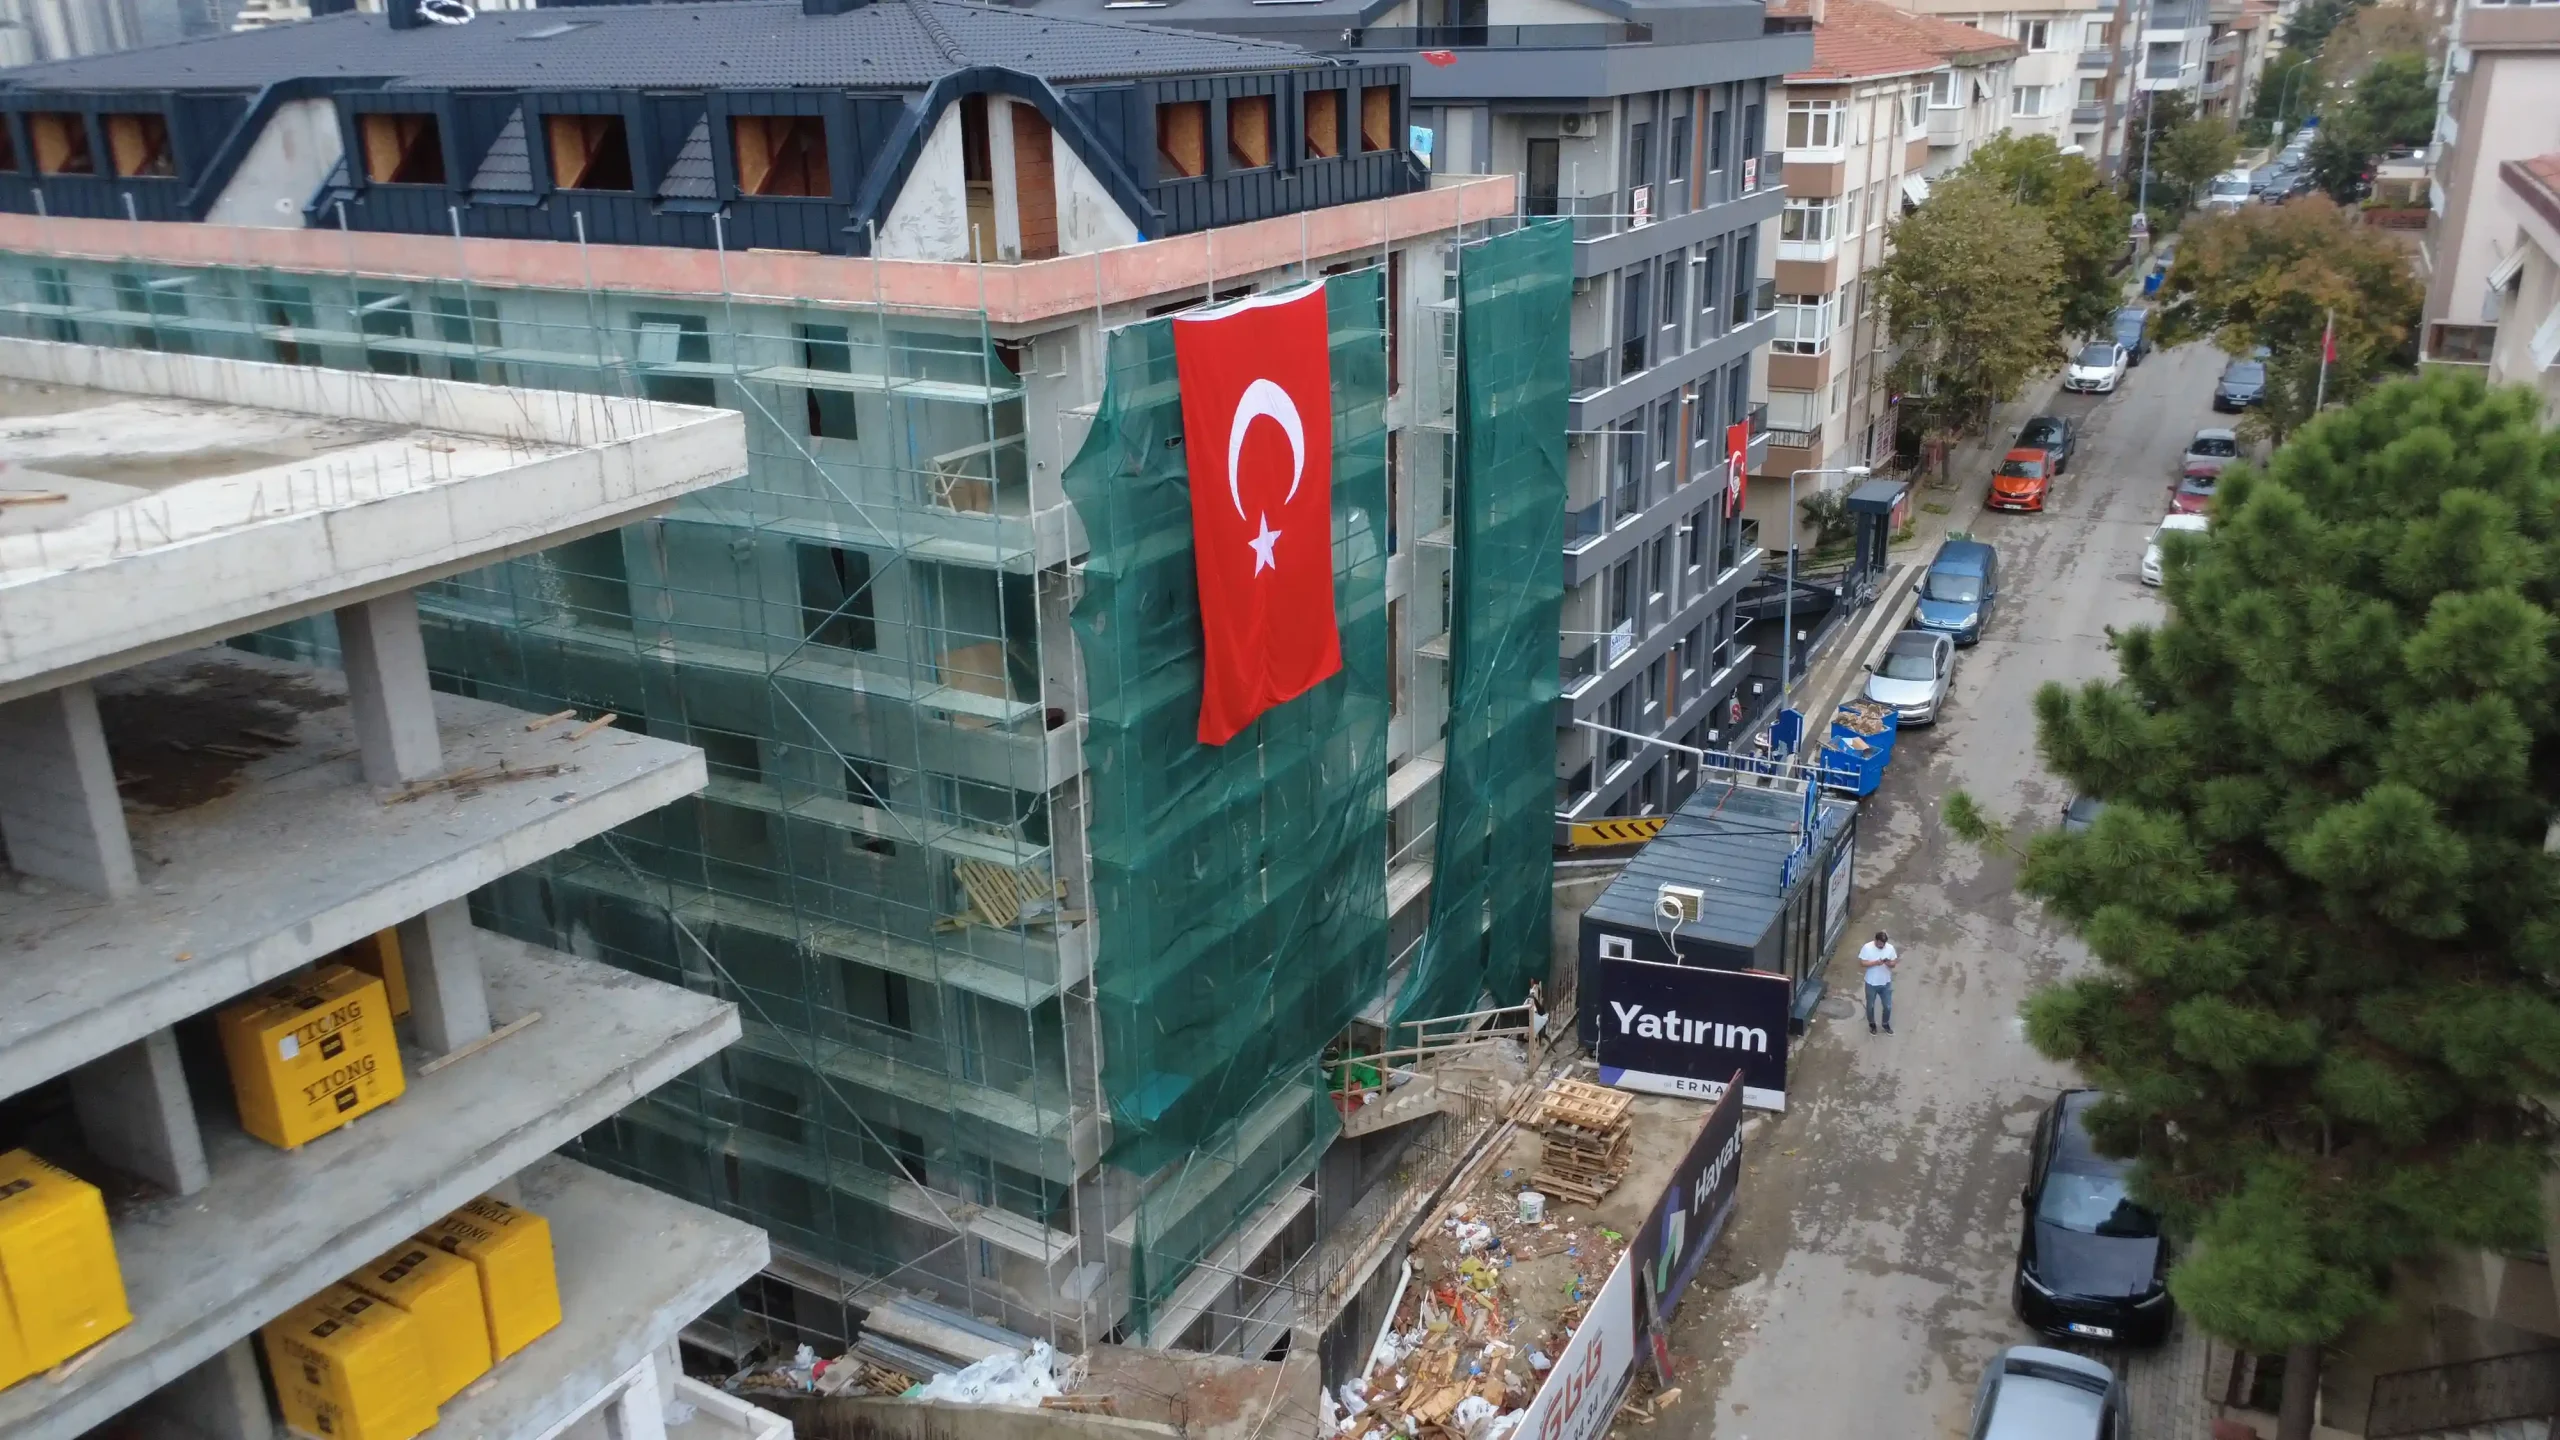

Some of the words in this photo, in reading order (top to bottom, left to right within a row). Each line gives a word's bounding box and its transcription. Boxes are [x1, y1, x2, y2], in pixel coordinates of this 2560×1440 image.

[1610, 1000, 1767, 1053] Yatırım
[302, 1054, 375, 1101] YTONG
[1693, 1118, 1741, 1216] Hayat
